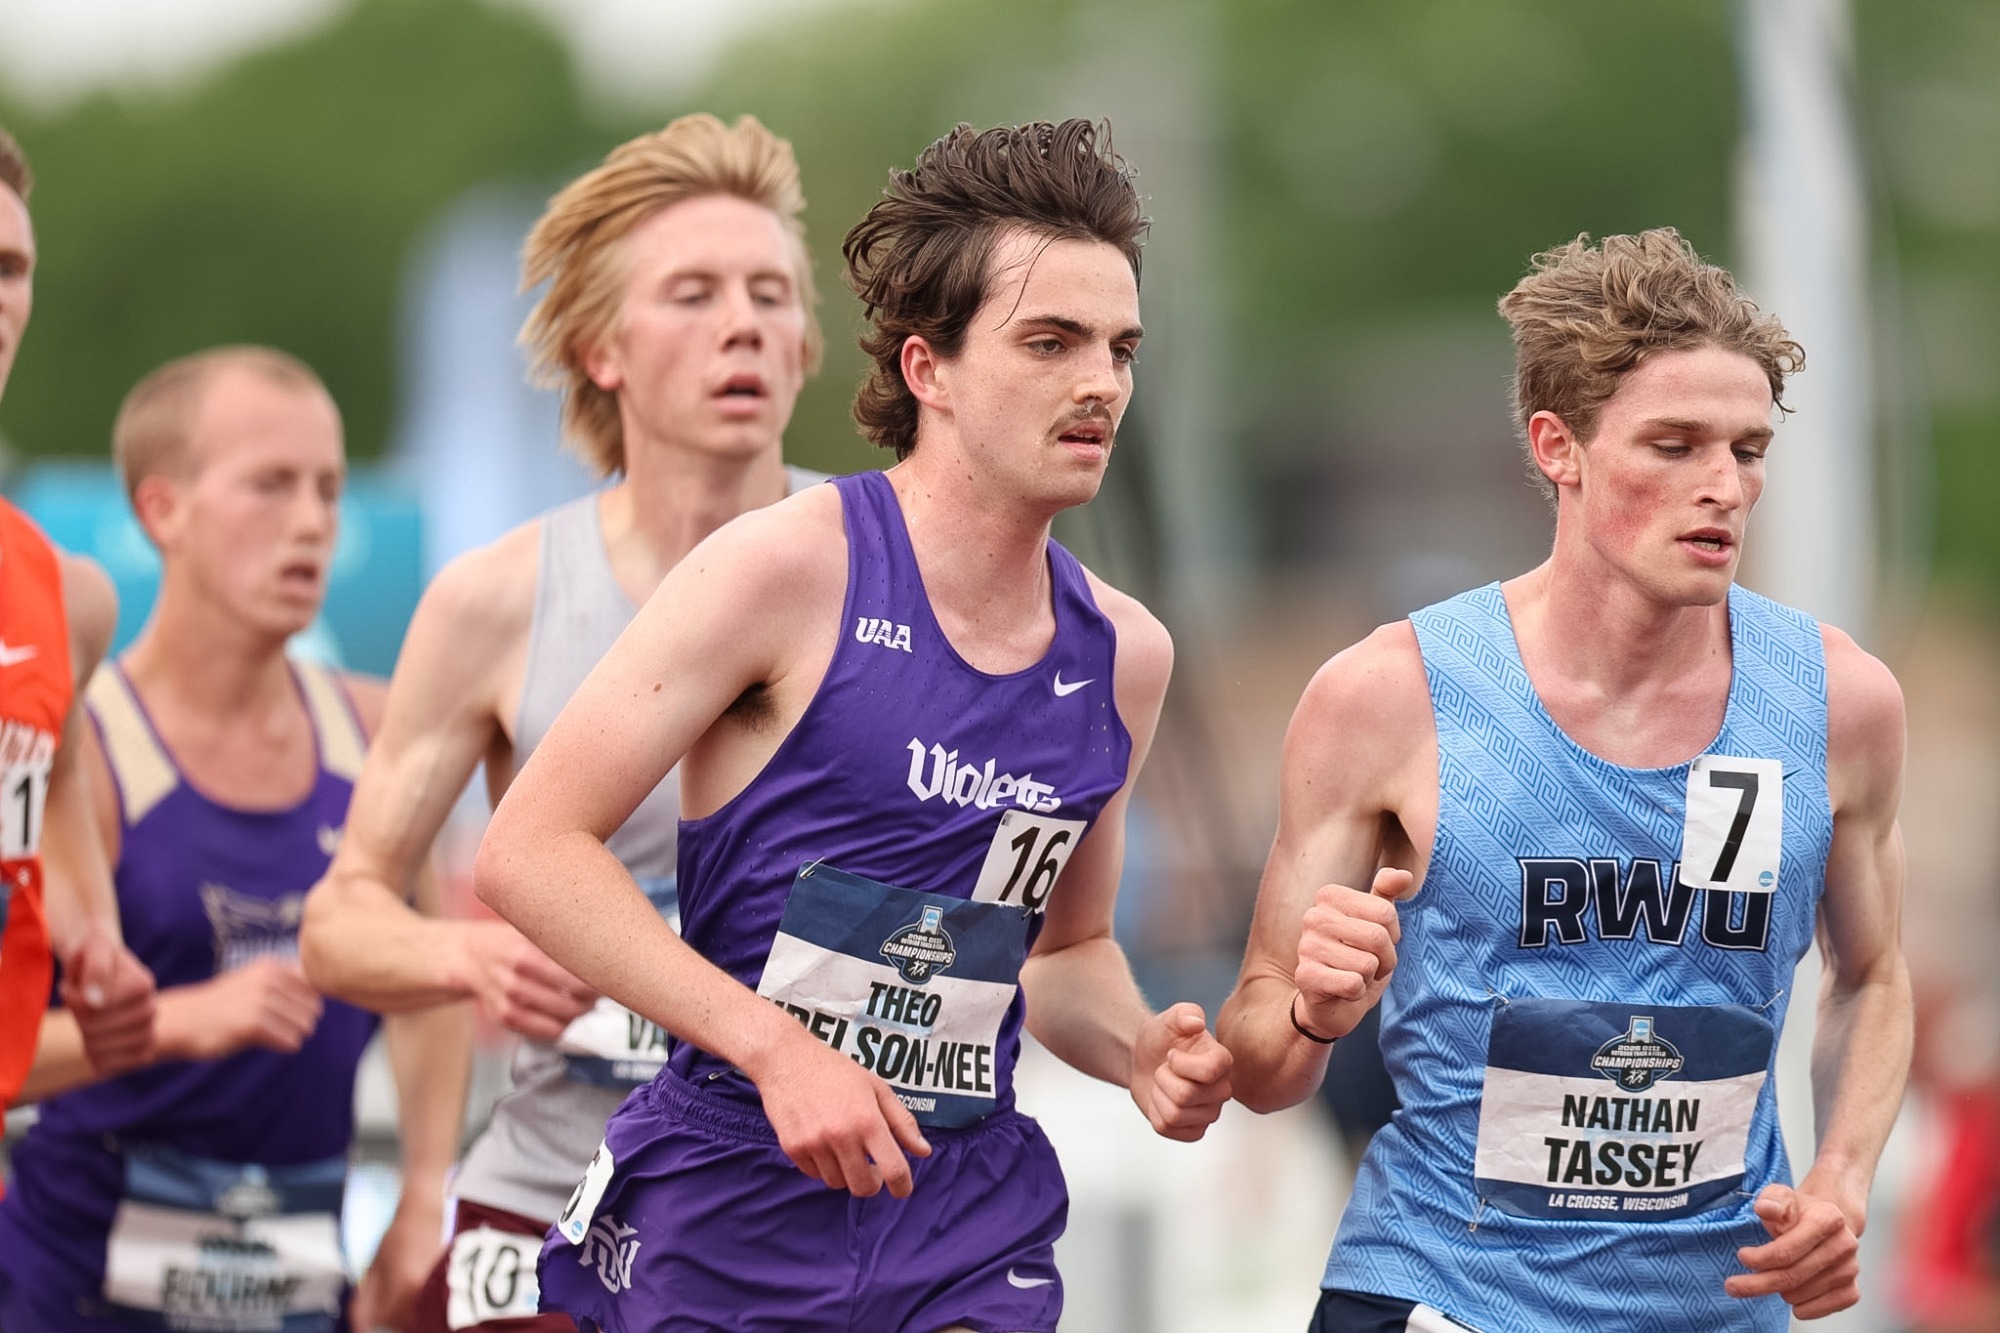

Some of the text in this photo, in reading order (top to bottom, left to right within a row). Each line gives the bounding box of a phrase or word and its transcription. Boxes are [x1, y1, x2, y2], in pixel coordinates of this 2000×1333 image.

[855, 617, 912, 652] UAA
[906, 737, 1062, 813] Violets
[1709, 770, 1759, 882] 7
[998, 826, 1070, 908] 16
[1518, 857, 1774, 951] RWU
[883, 942, 954, 964] CHAMPIONSHIPS
[866, 981, 942, 1028] THEO
[1594, 1056, 1681, 1069] CHAMPIONSHIPS
[1561, 1094, 1700, 1133] NATHAN
[1544, 1137, 1704, 1188] TASSEY
[1548, 1193, 1689, 1211] LA CROSSE, WISCONSIN
